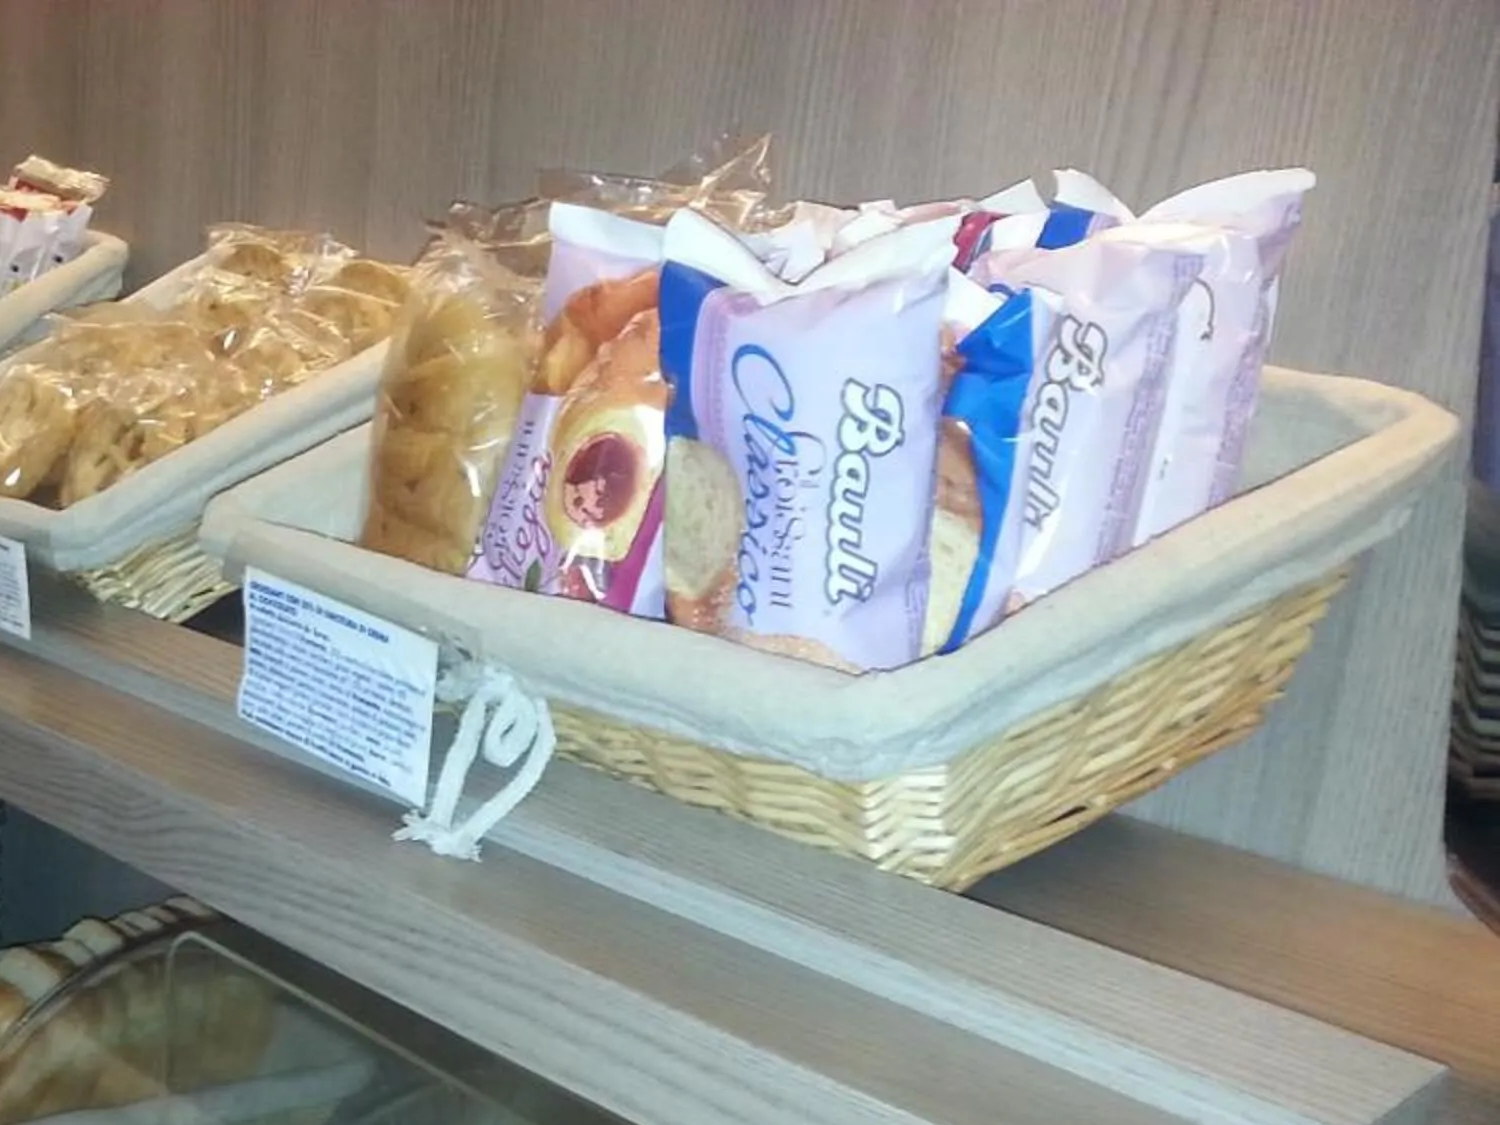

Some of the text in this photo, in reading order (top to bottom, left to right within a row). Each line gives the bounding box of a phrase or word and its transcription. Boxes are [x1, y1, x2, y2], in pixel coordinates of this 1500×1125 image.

[731, 343, 795, 627] Classico
[826, 378, 906, 606] Bauli
[1024, 314, 1108, 532] Bauli
